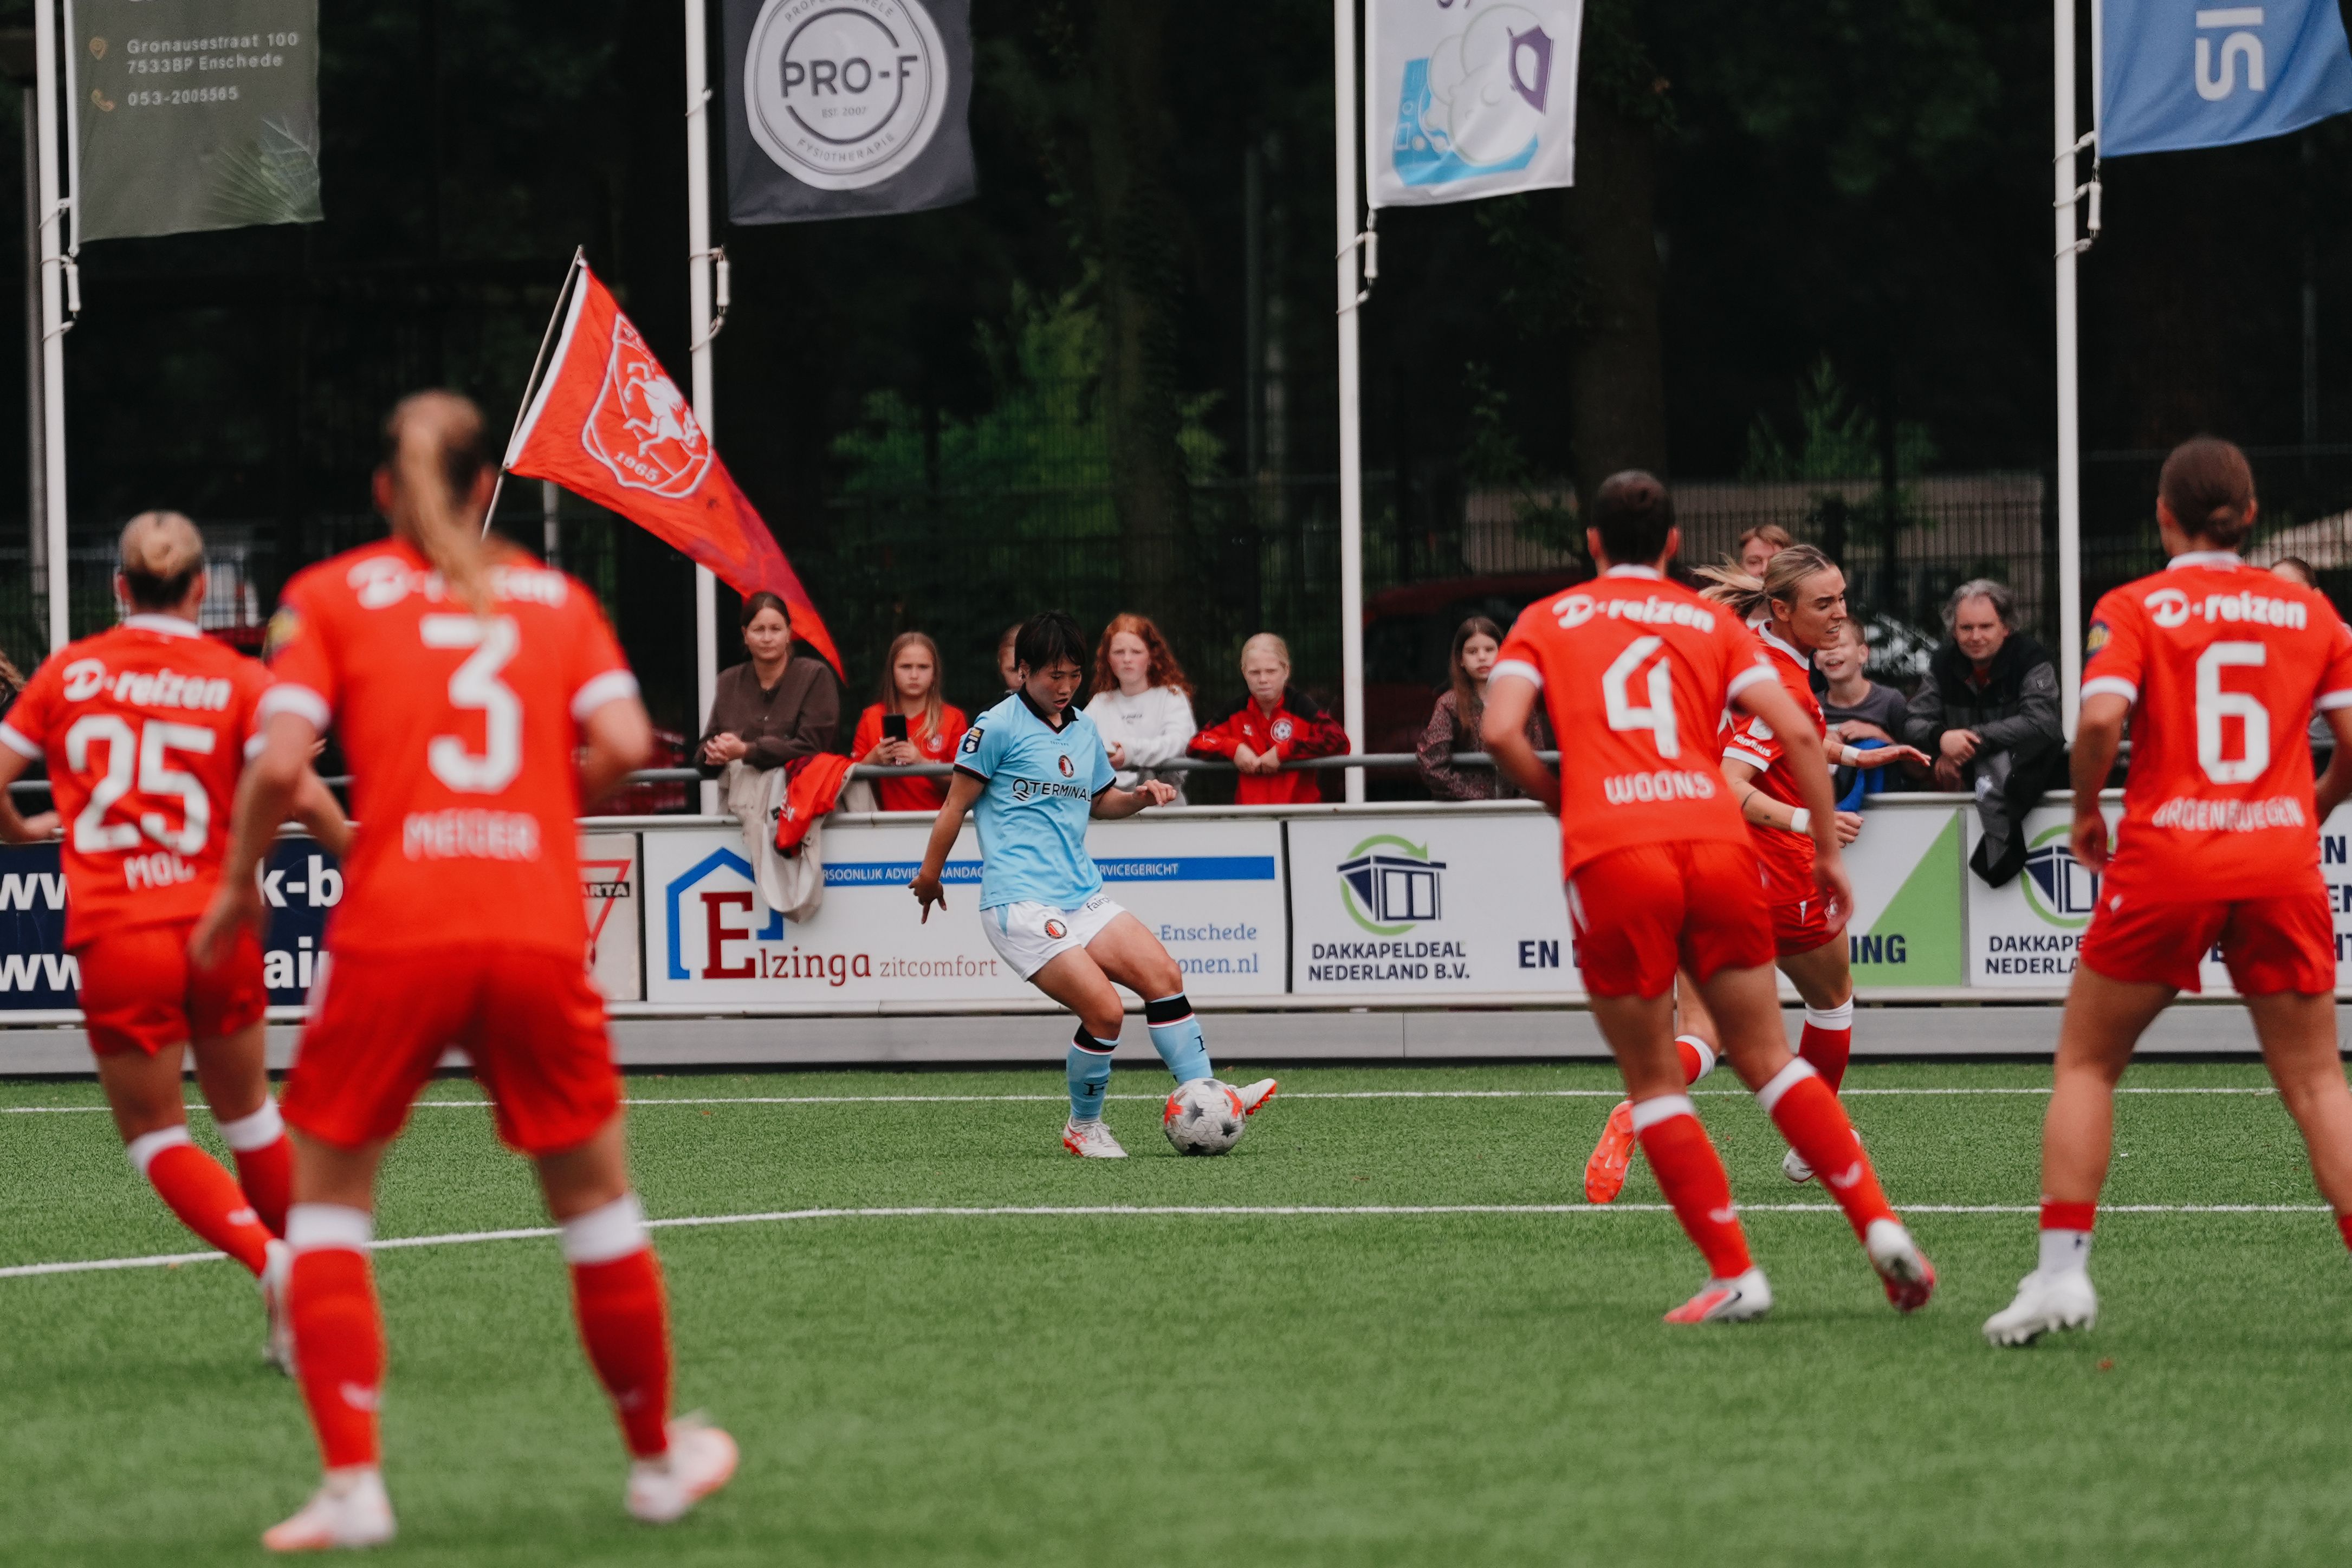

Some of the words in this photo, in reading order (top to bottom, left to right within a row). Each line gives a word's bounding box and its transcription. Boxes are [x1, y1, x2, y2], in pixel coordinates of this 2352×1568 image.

[267, 31, 298, 47] 100
[127, 57, 193, 74] 7533BP
[199, 53, 283, 70] Enschede
[780, 55, 917, 98] PRO-F
[797, 132, 895, 163] FYSIOTHERAPIE
[614, 451, 658, 482] 1965
[418, 612, 523, 794] 3
[1602, 636, 1679, 759] 4
[2195, 642, 2271, 784] 6
[65, 714, 215, 856] 25
[1604, 770, 1715, 805] WOONS
[701, 891, 871, 987] Elzinga
[879, 955, 998, 977] zitcomfort
[1312, 941, 1466, 960] DAKKAPELDEAL
[1518, 940, 1559, 968] EN
[1308, 963, 1428, 981] NEDERLAND
[1434, 963, 1470, 979] B.V.
